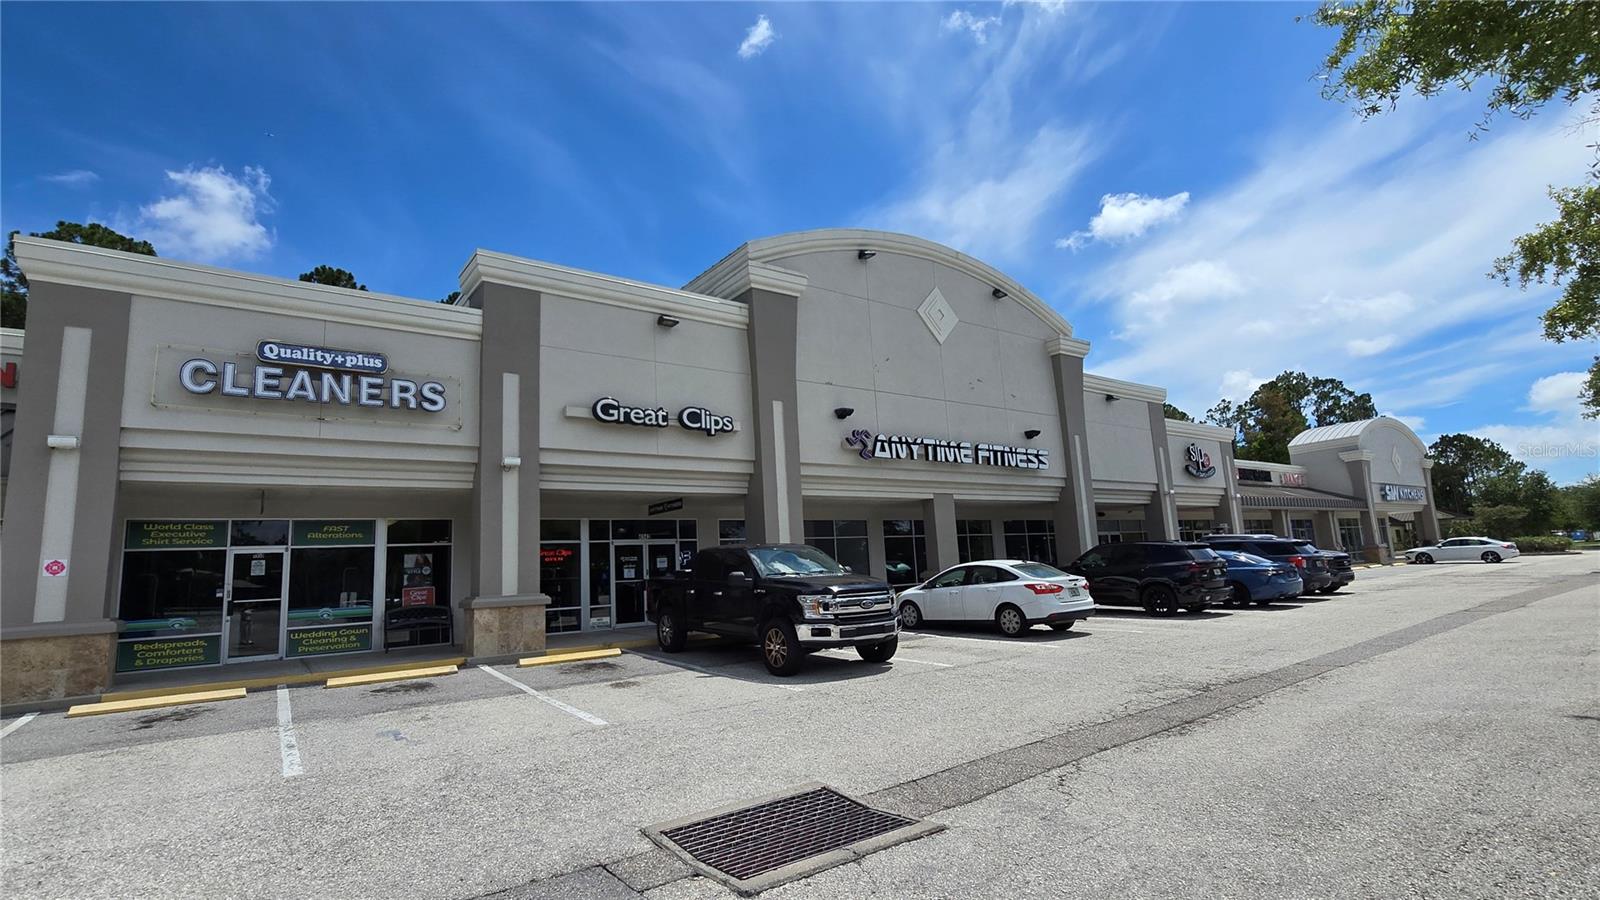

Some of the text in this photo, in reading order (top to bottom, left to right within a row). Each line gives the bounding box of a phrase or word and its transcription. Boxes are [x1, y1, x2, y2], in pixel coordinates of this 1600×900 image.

[262, 343, 383, 369] Quality+plus
[179, 358, 447, 413] CLEANERS
[594, 398, 734, 436] Great Clips
[873, 433, 1050, 470] ANYTIME FITNESS
[143, 522, 215, 531] World Class
[150, 530, 207, 538] Executive
[307, 531, 364, 539] Alterations
[142, 538, 169, 546] Shirt
[290, 628, 369, 640] Wedding Gown
[302, 636, 348, 646] Cleaning
[297, 641, 361, 653] Preservation
[136, 648, 204, 658] Comforters
[146, 654, 205, 665] Draperies
